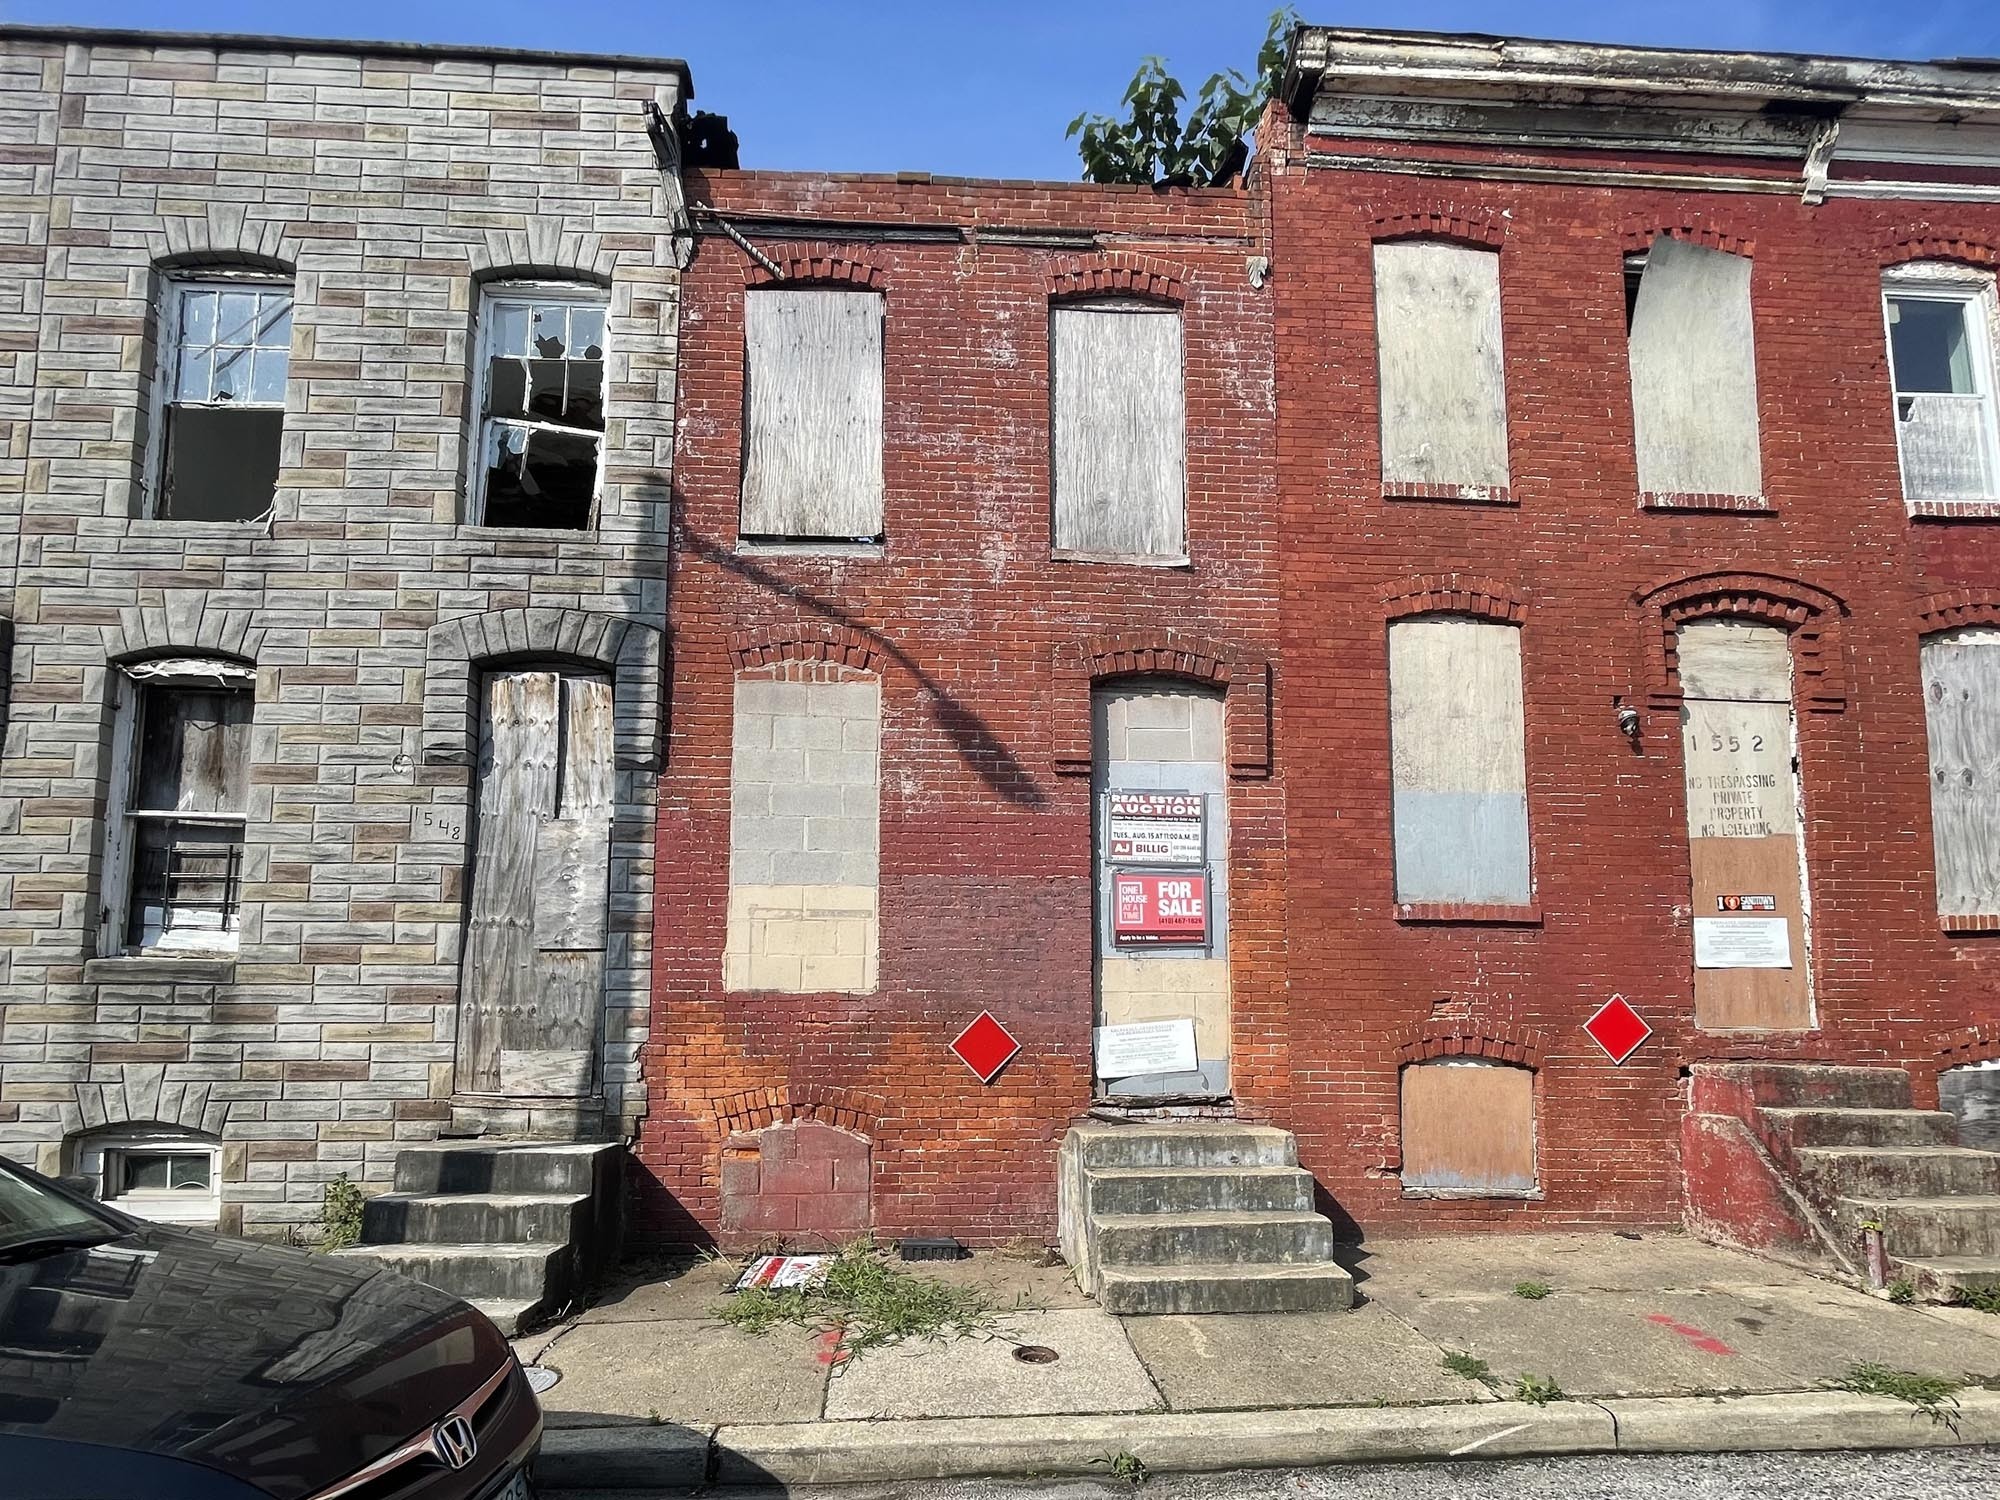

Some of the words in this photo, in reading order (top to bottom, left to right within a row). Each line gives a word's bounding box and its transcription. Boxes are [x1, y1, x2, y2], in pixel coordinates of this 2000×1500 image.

[1692, 735, 1763, 752] 1552
[1708, 774, 1776, 789] TRESPASSING
[1112, 794, 1146, 803] REAL
[1150, 795, 1201, 805] ESTATE
[1713, 791, 1755, 805] PRIVATE
[1112, 803, 1201, 816] AUCTION
[1710, 806, 1763, 820] PROPERTY
[415, 806, 461, 840] 1548
[1114, 842, 1130, 853] AJ
[1135, 844, 1169, 853] BILLIG
[1122, 886, 1139, 894] ONE
[1158, 881, 1192, 898] FOR
[1122, 894, 1148, 903] HOUSE
[1122, 903, 1132, 911] AT
[1132, 903, 1139, 911] A
[1158, 899, 1203, 916] SALE
[1122, 911, 1140, 919] TIME
